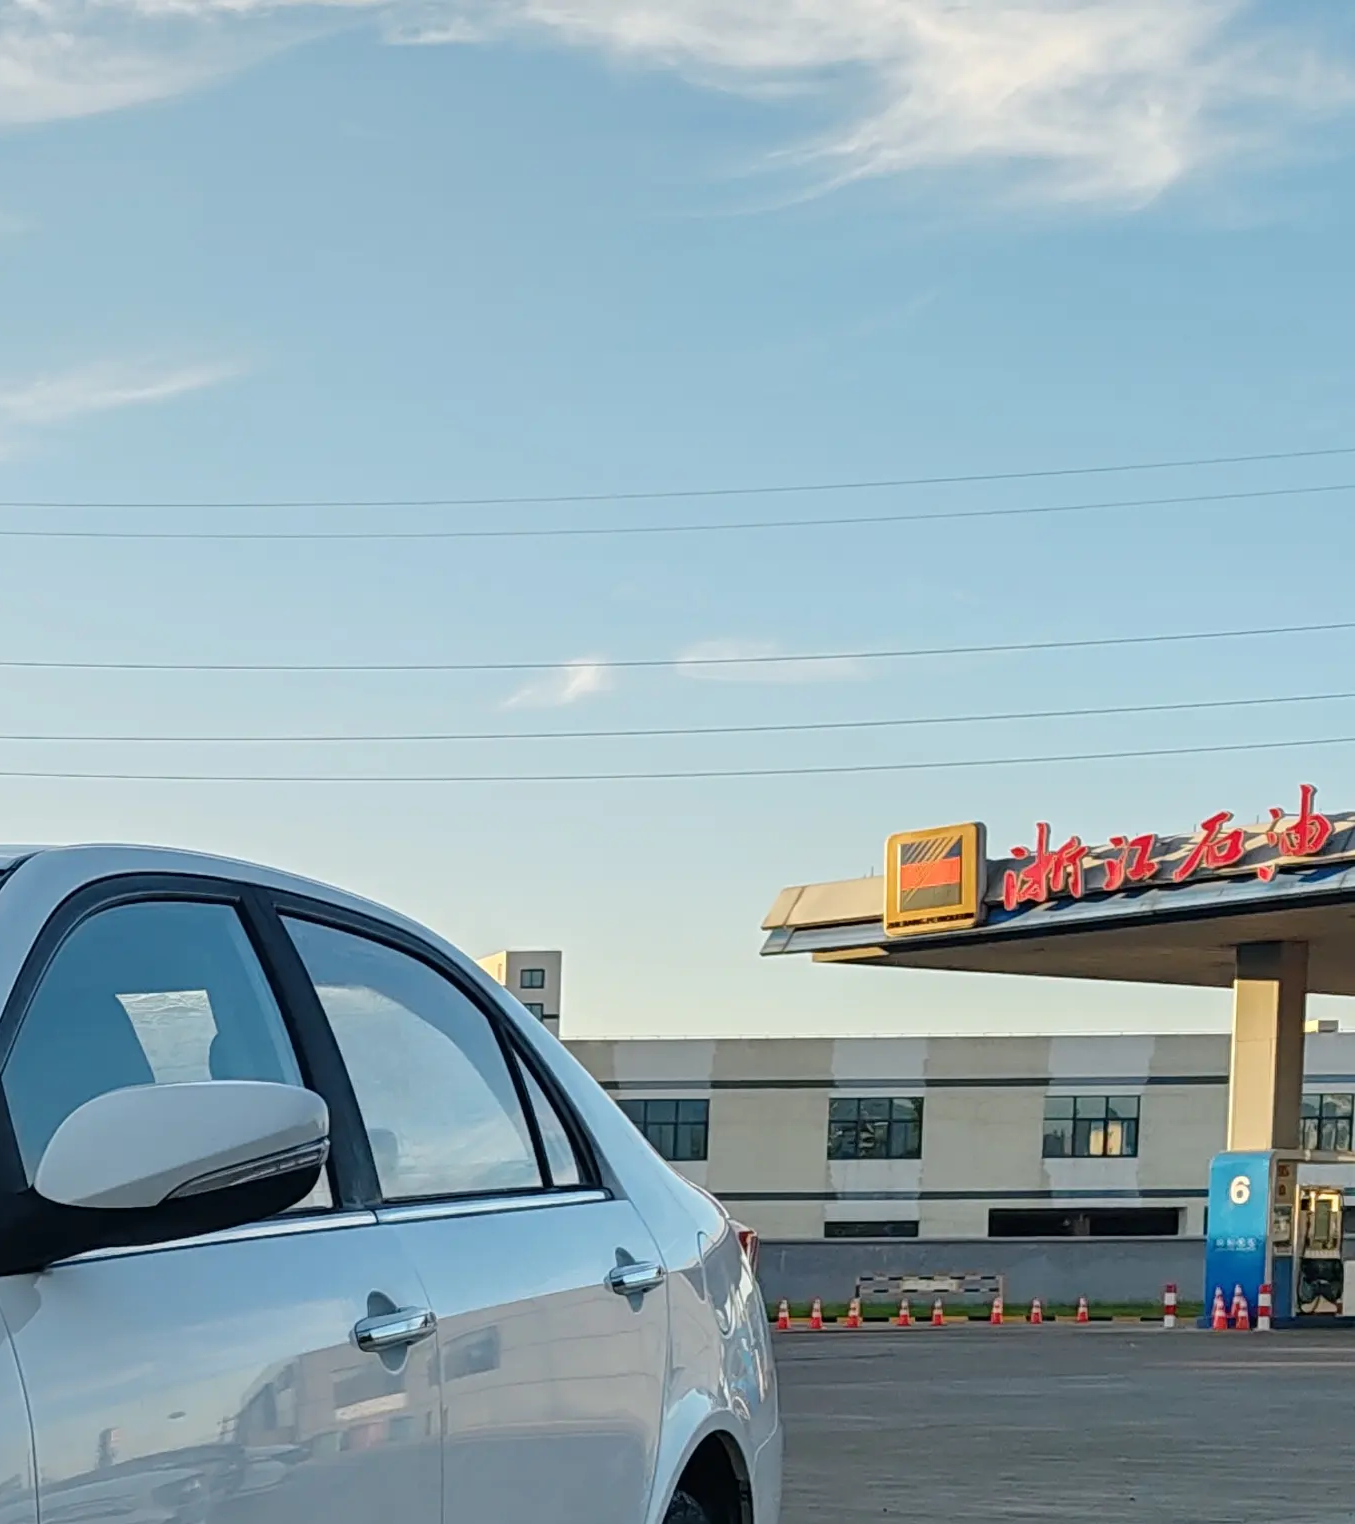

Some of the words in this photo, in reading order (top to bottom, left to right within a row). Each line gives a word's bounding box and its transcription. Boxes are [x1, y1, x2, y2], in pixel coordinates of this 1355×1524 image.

[1004, 784, 1332, 911] 浙江石油
[1229, 1175, 1252, 1205] 6
